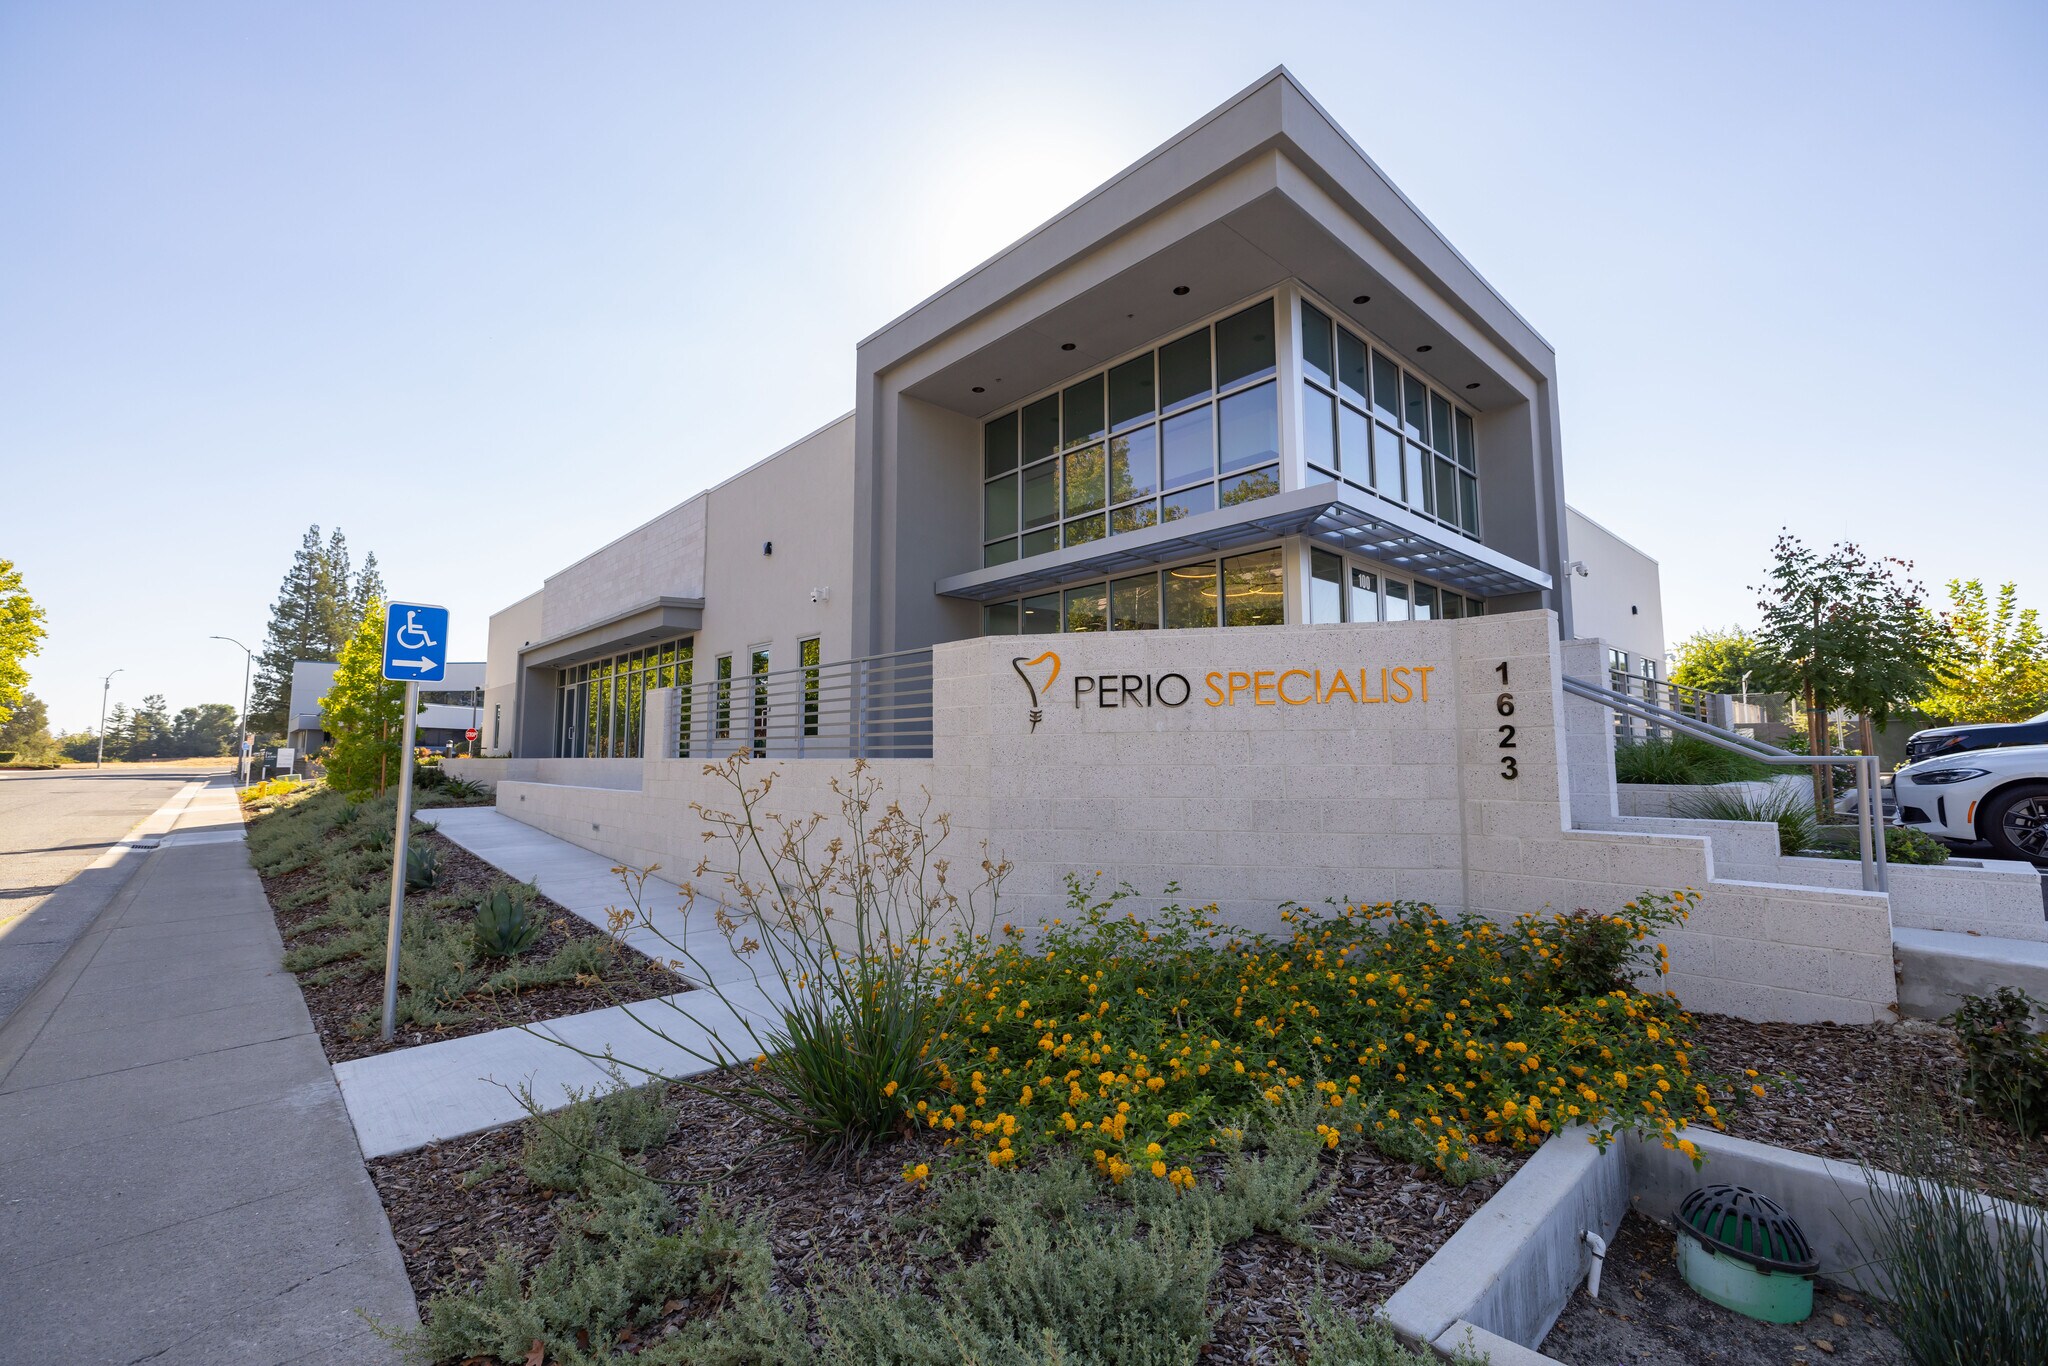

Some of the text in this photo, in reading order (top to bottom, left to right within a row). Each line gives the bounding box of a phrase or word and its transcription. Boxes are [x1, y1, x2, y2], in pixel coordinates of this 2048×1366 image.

[1358, 573, 1371, 590] 100
[1074, 666, 1435, 709] PERIO SPECIALIST
[1495, 661, 1519, 780] 1623
